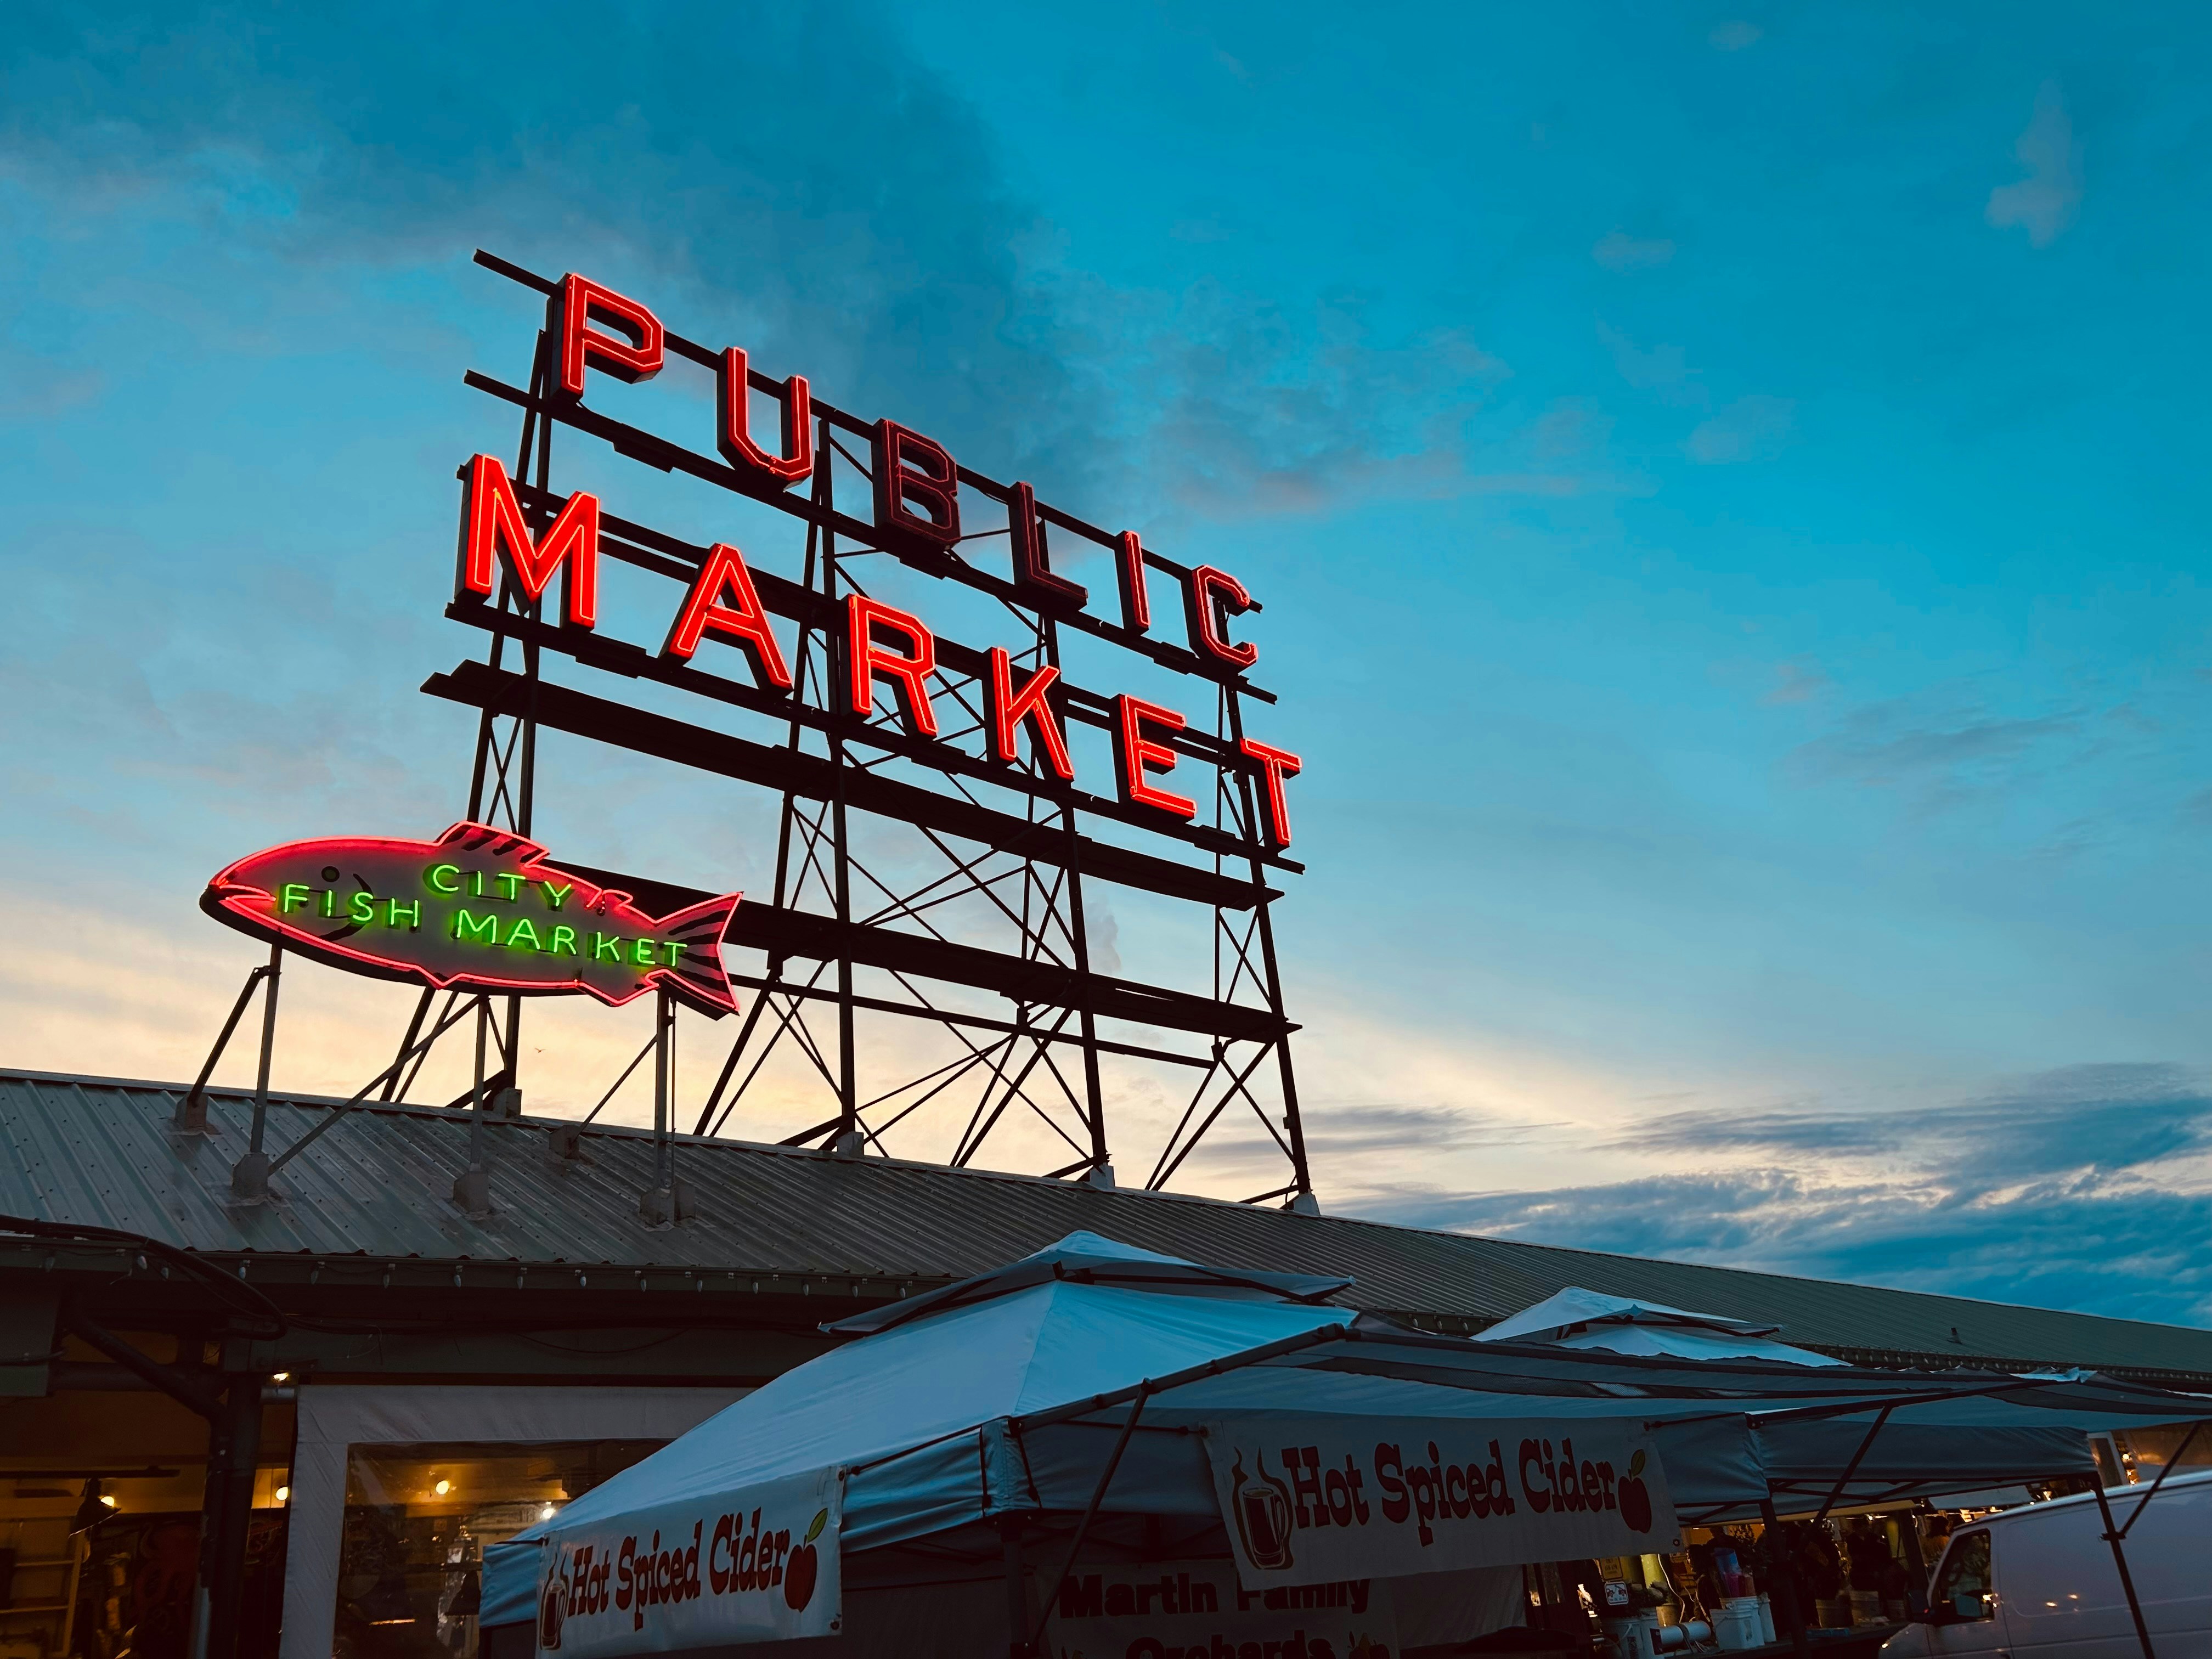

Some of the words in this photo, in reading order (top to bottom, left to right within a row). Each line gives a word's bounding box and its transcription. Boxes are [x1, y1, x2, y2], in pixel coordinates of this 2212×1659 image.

[552, 273, 1259, 672] PUBLIC
[455, 453, 1303, 851] MARKET
[282, 883, 421, 928] FISH
[455, 908, 688, 968] MARKET
[429, 863, 573, 910] CITY
[1281, 1446, 1369, 1530] Hot
[1374, 1438, 1516, 1547] Spiced
[1518, 1437, 1616, 1514] Cider
[567, 1544, 610, 1617] Hot
[616, 1519, 703, 1632] Spiced
[709, 1506, 791, 1595] Cider
[1059, 1572, 1219, 1619] Martin
